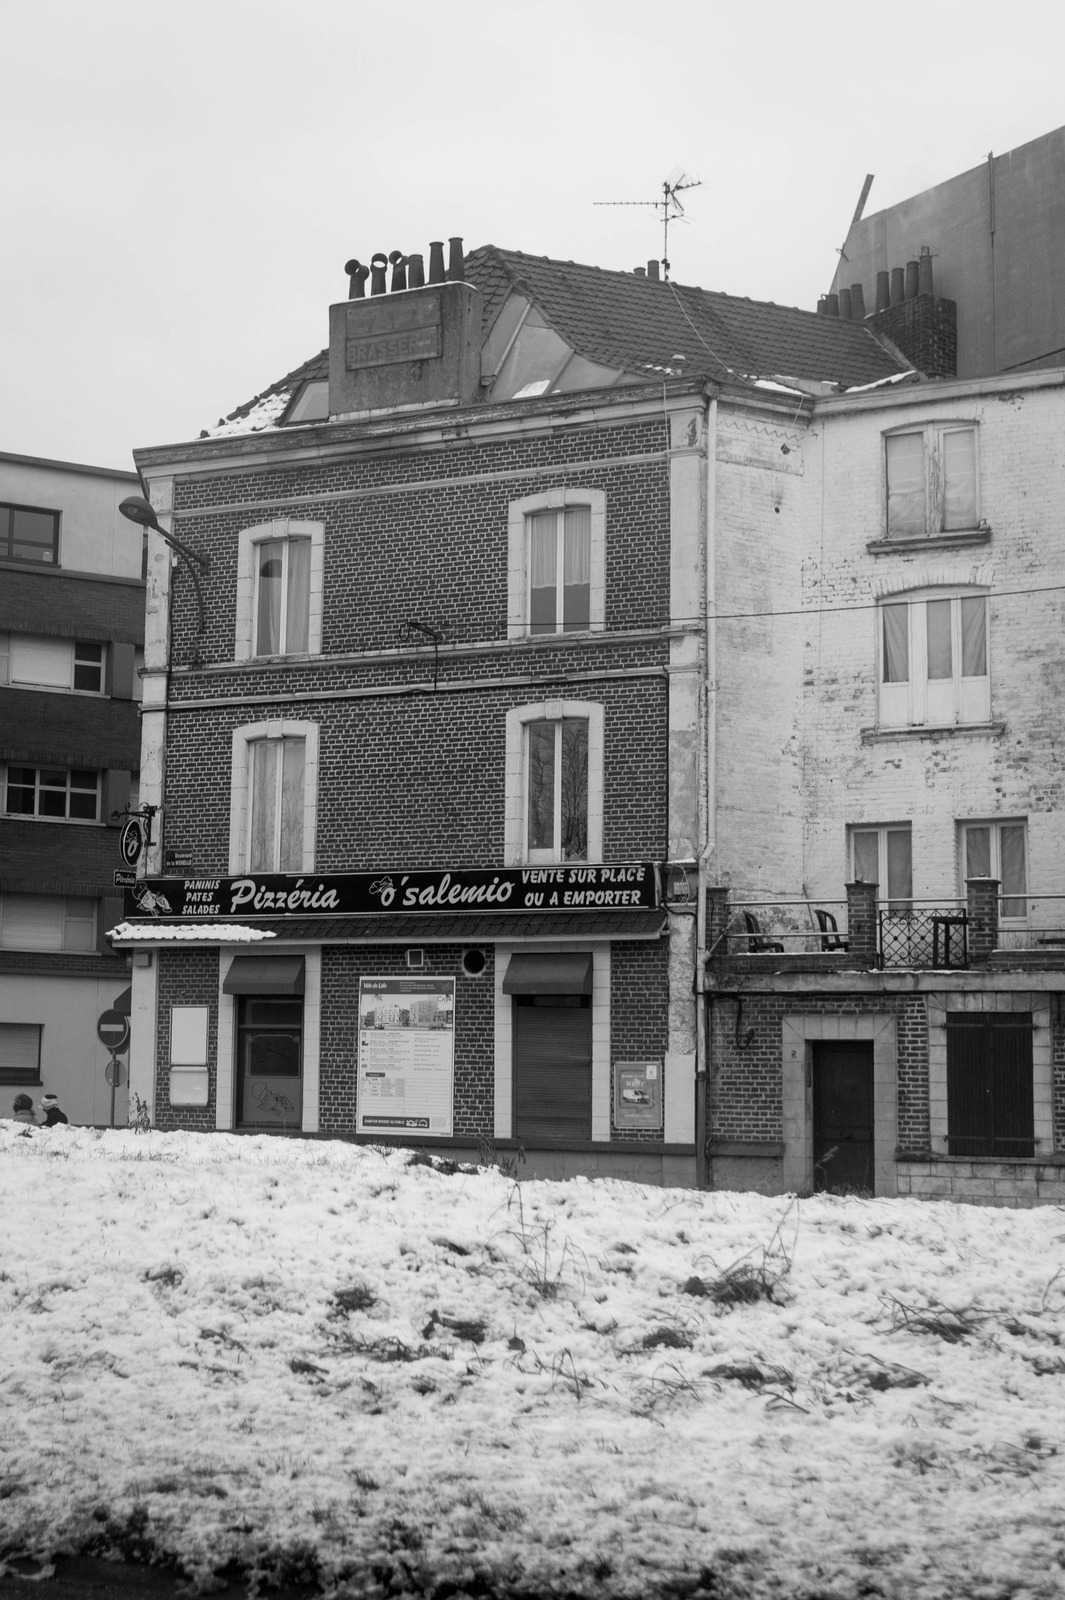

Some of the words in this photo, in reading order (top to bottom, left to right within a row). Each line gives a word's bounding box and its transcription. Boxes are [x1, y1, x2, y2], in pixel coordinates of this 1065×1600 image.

[521, 869, 564, 884] VENTE
[569, 869, 596, 884] SUR
[601, 867, 646, 882] PLACE
[184, 880, 220, 890] PANINIS
[185, 892, 213, 902] PATES
[230, 879, 340, 914] Pizzéria
[524, 892, 544, 906] OU
[550, 891, 559, 906] A
[564, 890, 641, 905] EMPORTER
[182, 904, 220, 915] SALADES
